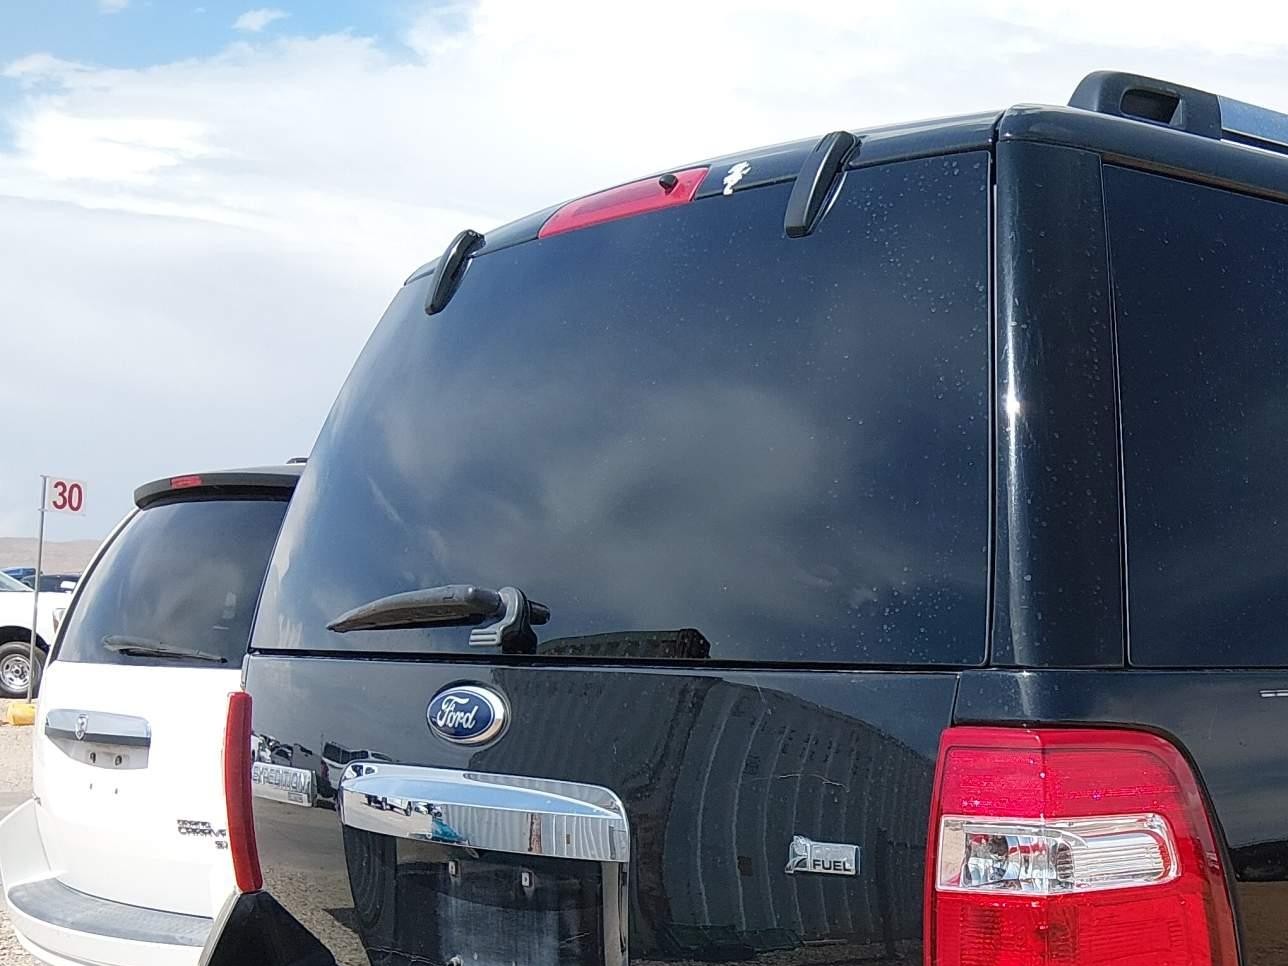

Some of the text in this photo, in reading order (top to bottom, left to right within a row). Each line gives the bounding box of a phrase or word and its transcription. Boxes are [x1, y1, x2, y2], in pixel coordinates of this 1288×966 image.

[52, 481, 83, 512] 30
[436, 695, 479, 729] Ford
[813, 859, 852, 873] FUEL
